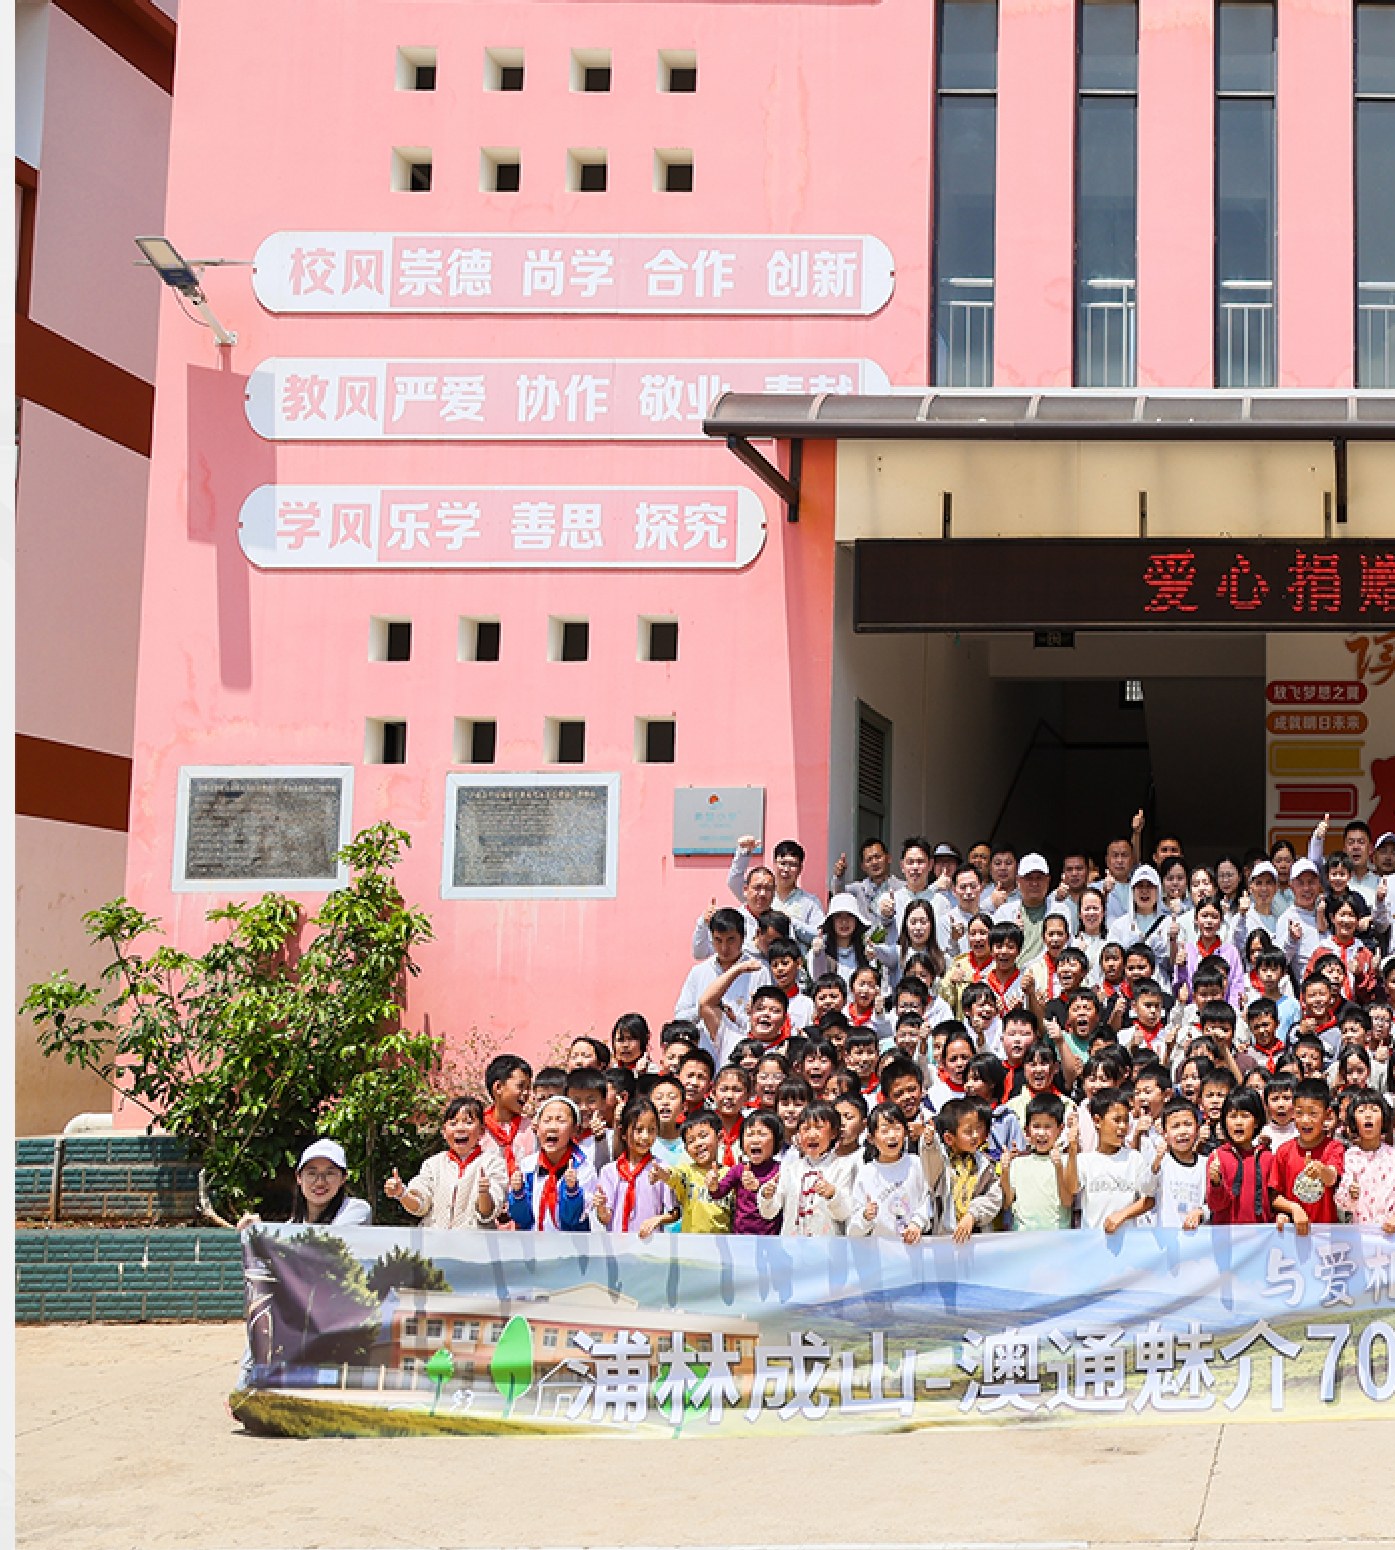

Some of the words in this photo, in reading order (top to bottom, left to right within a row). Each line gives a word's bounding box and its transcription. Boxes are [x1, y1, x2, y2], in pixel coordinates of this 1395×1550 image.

[288, 247, 385, 296] 校风
[397, 247, 493, 297] 崇德
[522, 249, 614, 297] 尚学
[643, 249, 737, 298] 合作
[766, 249, 858, 298] 创新
[281, 374, 379, 422] 教风
[391, 374, 487, 423] 严爱
[515, 374, 611, 423] 协作
[276, 501, 373, 550] 学风
[386, 502, 482, 550] 乐学
[510, 501, 604, 551] 善思
[633, 501, 728, 551] 探究
